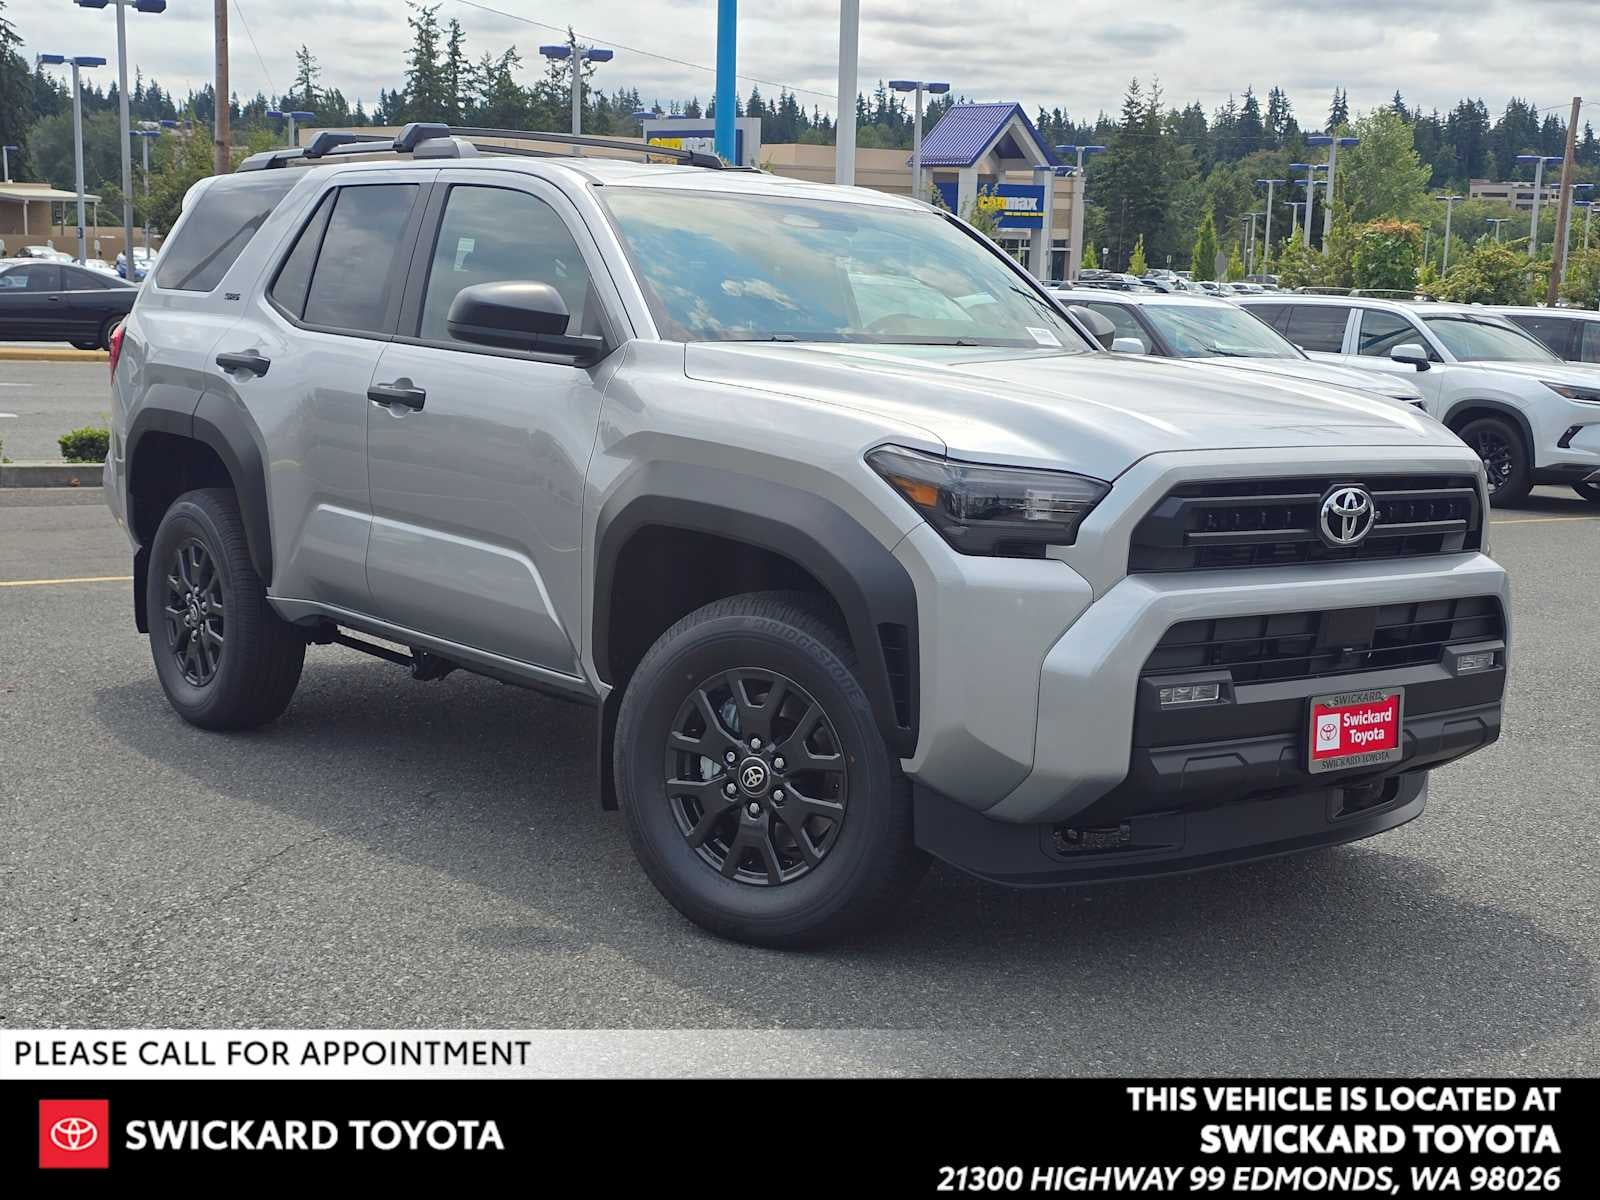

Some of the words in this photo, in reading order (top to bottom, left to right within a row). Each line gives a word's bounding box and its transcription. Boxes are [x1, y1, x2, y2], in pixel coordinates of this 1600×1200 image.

[1334, 691, 1383, 706] SWICKARD
[1343, 707, 1392, 727] Swickard
[1349, 727, 1385, 746] Toyota
[1321, 754, 1361, 769] SWICKARD
[1362, 751, 1390, 764] TOYOTA
